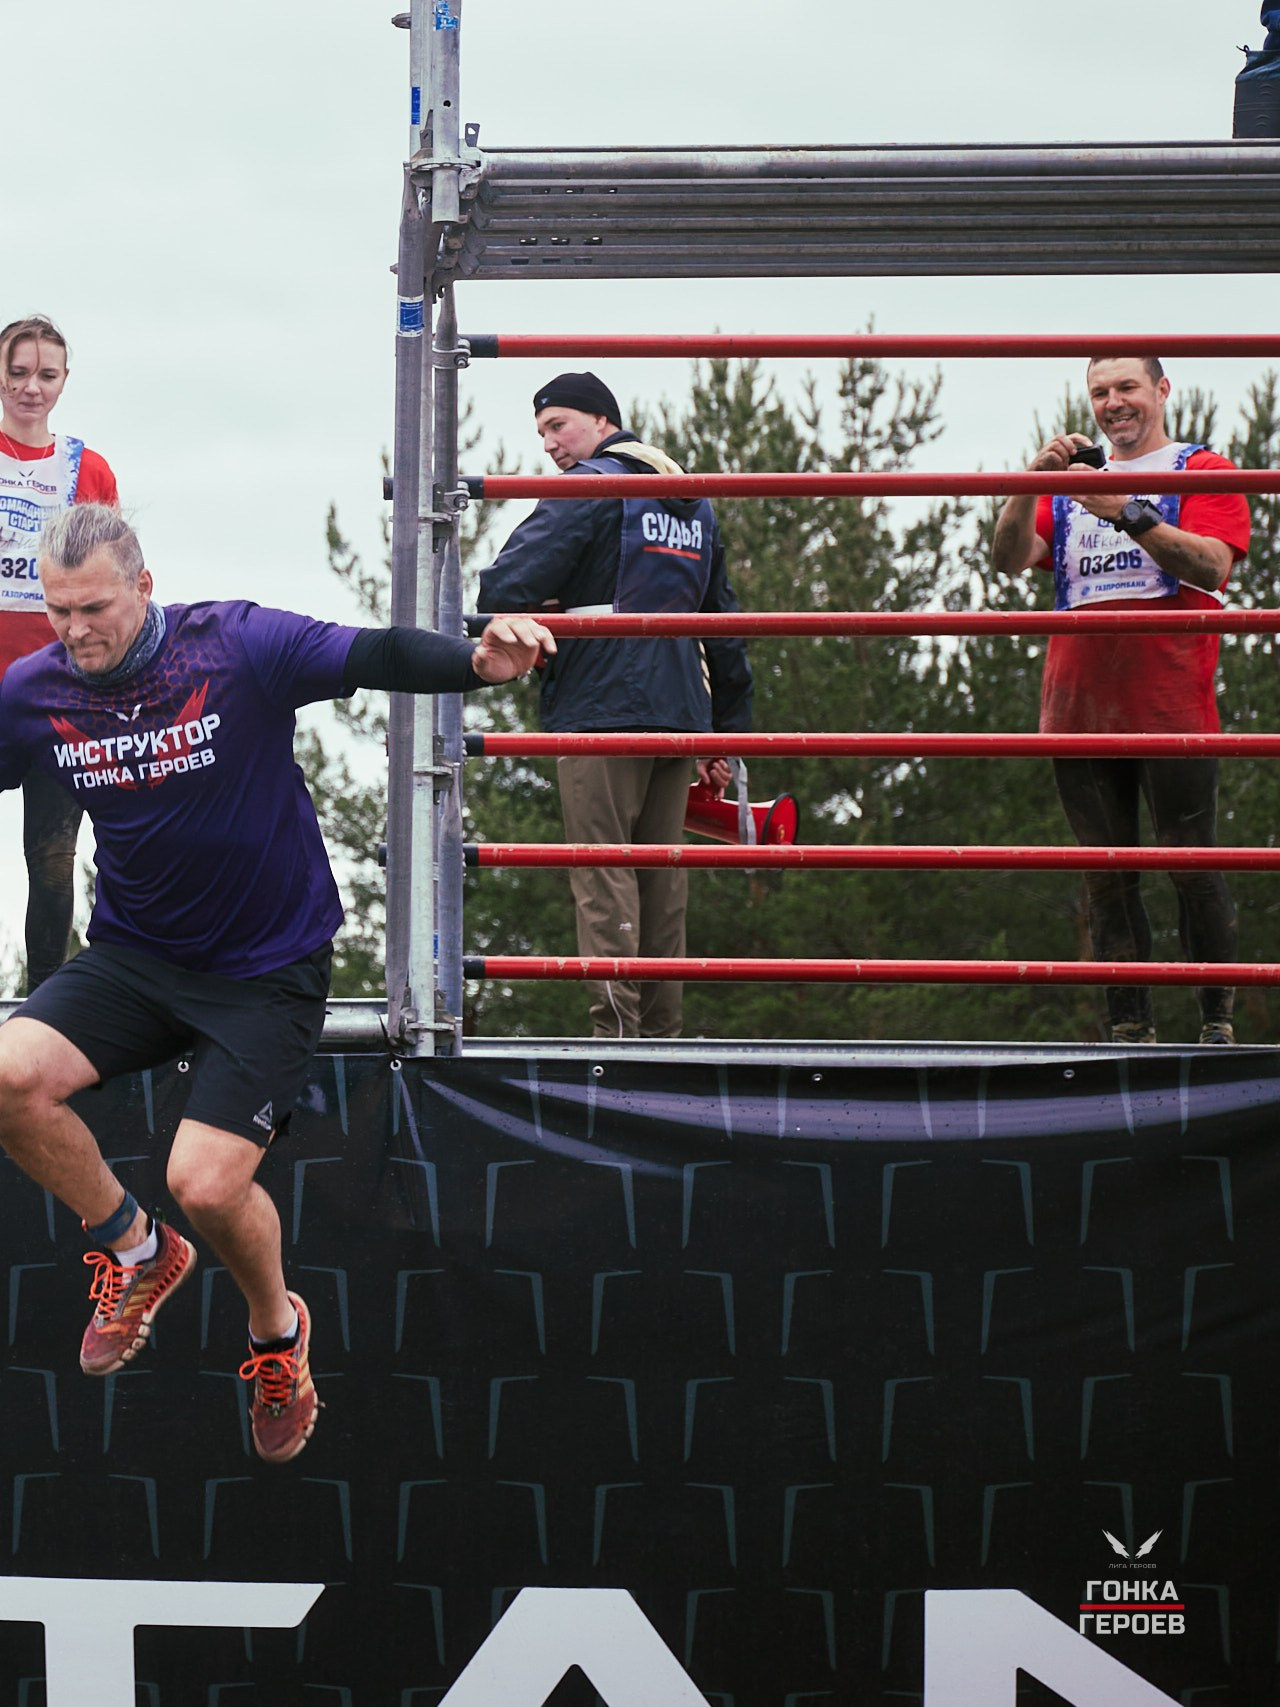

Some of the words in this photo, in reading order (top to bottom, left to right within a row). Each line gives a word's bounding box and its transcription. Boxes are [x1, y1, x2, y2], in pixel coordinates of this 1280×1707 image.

[26, 479, 58, 492] ГЕРОЕВ
[9, 512, 40, 532] СТАРТ
[642, 512, 702, 549] СУДЬЯ
[1078, 533, 1133, 549] АЛЕКСАН
[1080, 549, 1142, 577] 03206
[1, 590, 44, 601] ГАЗПРОМБА
[1095, 580, 1147, 592] ГАЗПРОМБАНК
[53, 713, 221, 768] ИНСТРУКТОР
[73, 766, 135, 790] ГОНКА
[138, 748, 216, 780] ГЕРОЕВ
